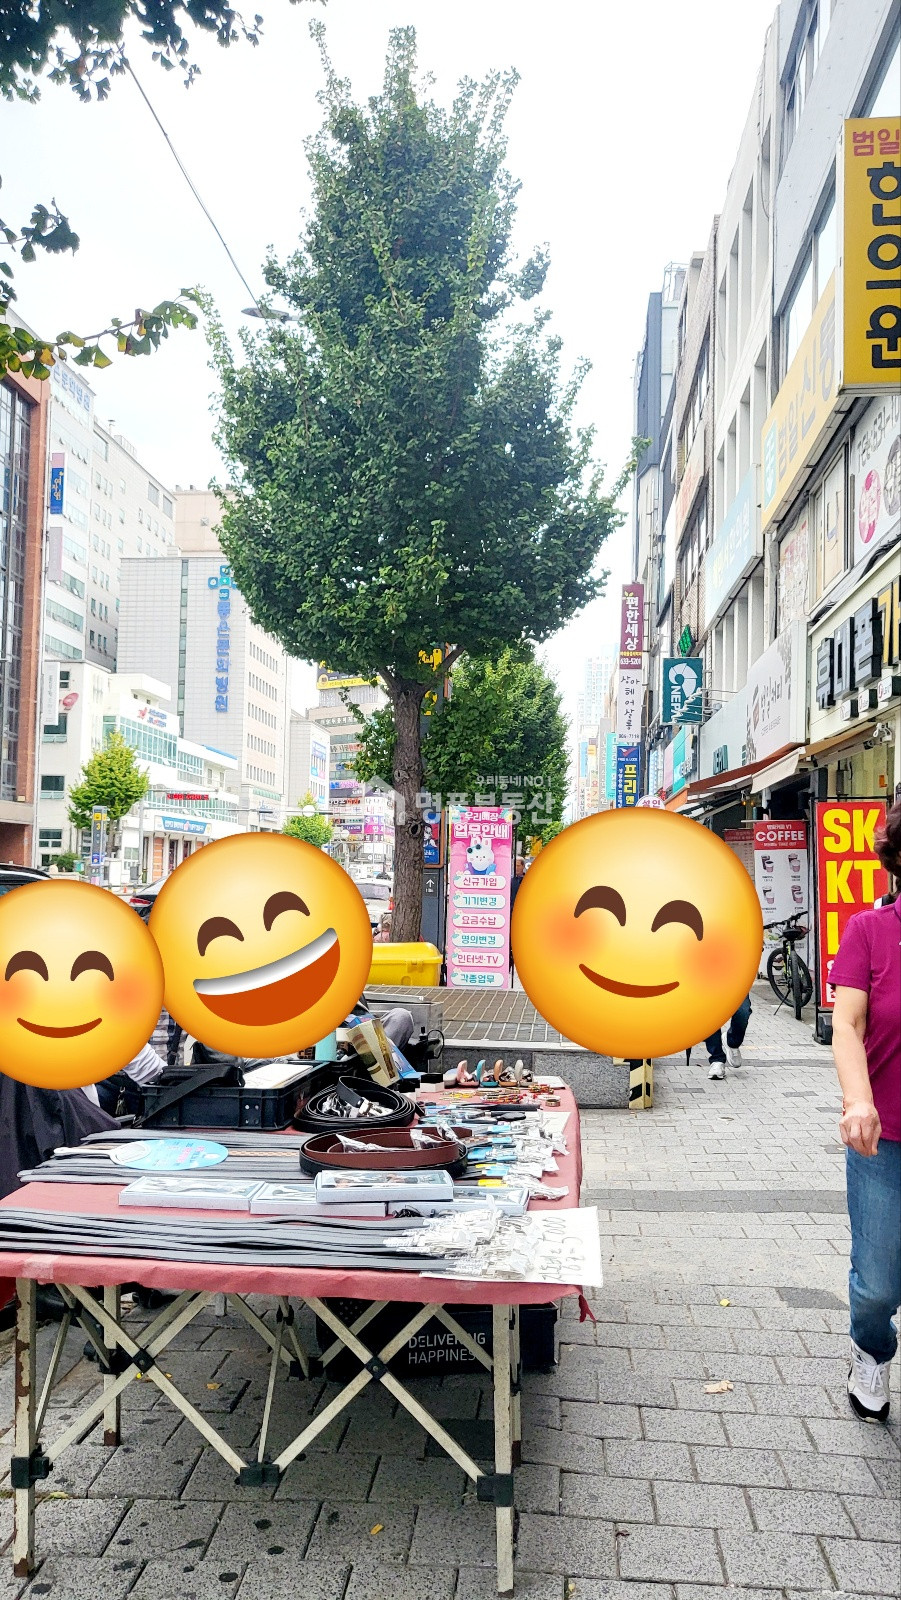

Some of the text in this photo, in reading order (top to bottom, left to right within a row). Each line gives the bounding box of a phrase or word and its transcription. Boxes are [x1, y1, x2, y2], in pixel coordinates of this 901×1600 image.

[853, 128, 900, 157] 범일
[624, 596, 640, 651] 편한세상
[464, 811, 499, 822] 우리매장
[454, 822, 510, 839] 업무안내
[755, 830, 805, 842] COFFEE
[823, 808, 880, 854] SK
[463, 877, 497, 887] 신규가입
[825, 859, 882, 904] KT
[462, 896, 497, 907] 기기변경
[461, 916, 497, 926] 요금수납
[461, 935, 496, 945] 명의변경
[461, 974, 495, 984] 각종업무
